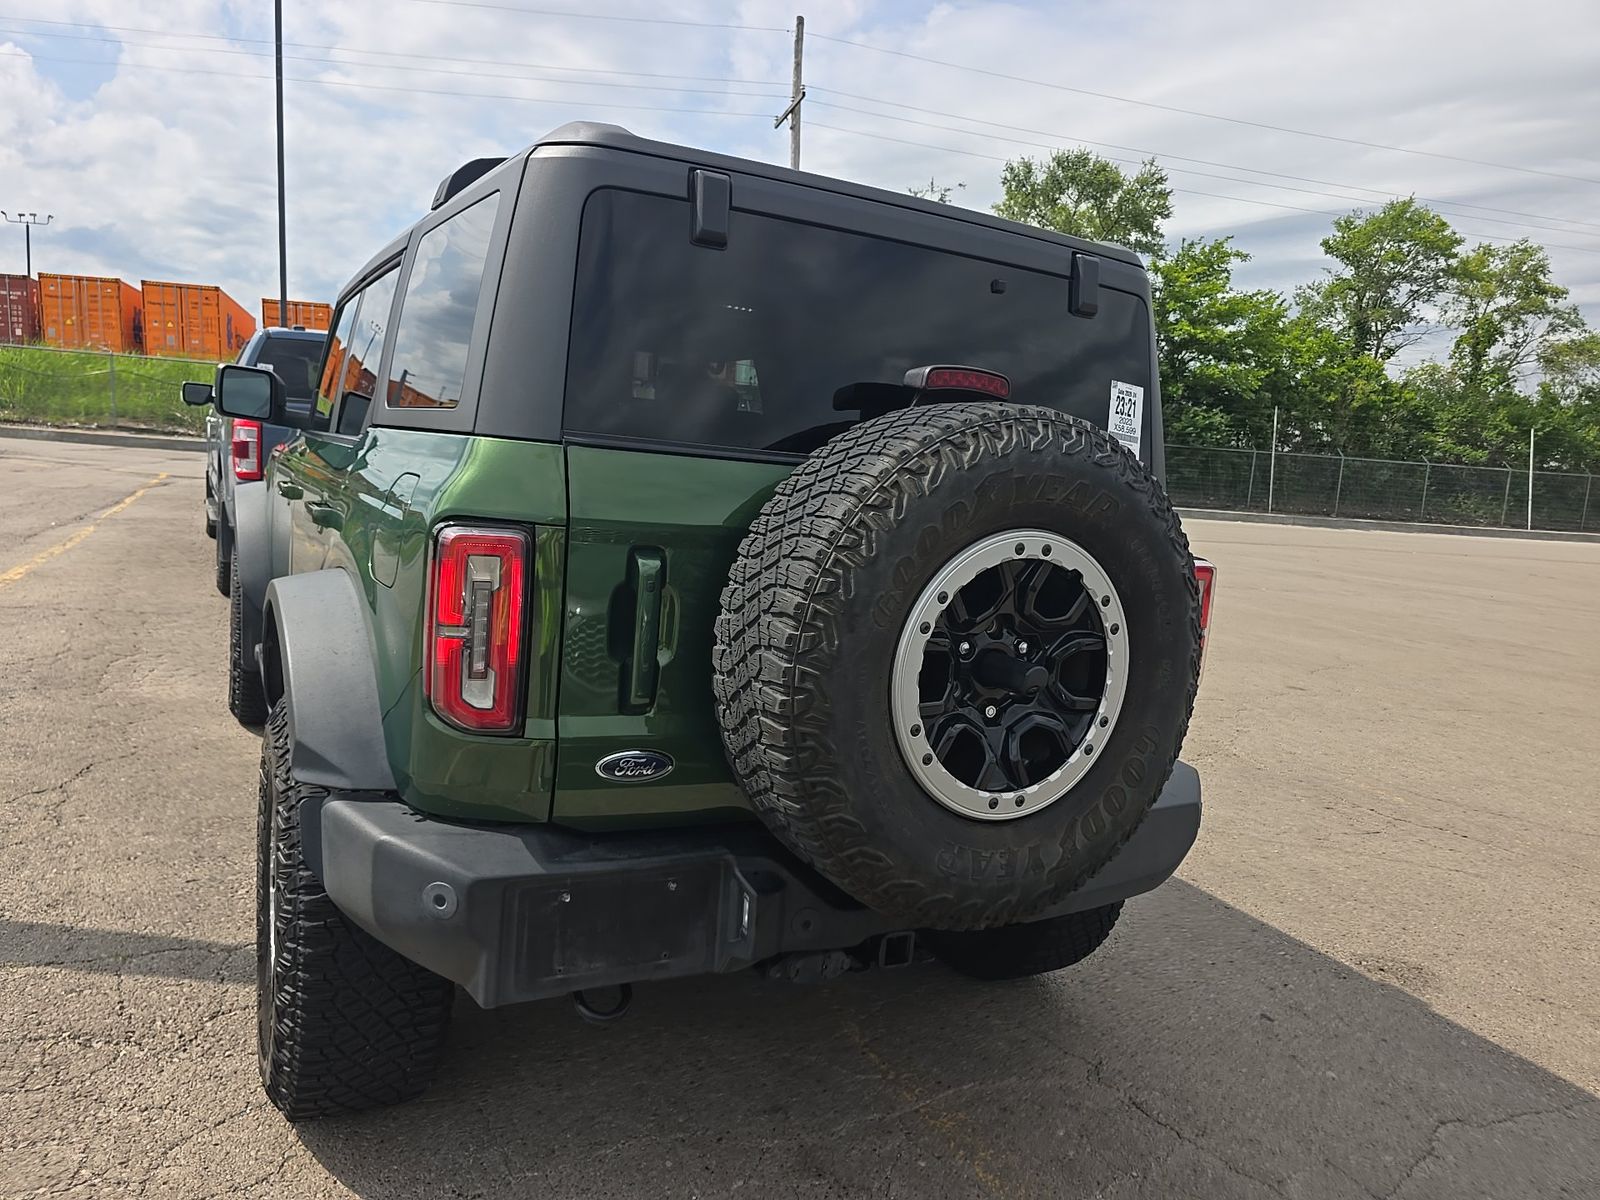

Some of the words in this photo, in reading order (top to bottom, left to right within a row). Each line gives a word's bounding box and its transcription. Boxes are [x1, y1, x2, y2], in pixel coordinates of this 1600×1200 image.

[1115, 395, 1137, 418] 23:21
[1118, 416, 1133, 426] 2023
[614, 757, 657, 776] Ford
